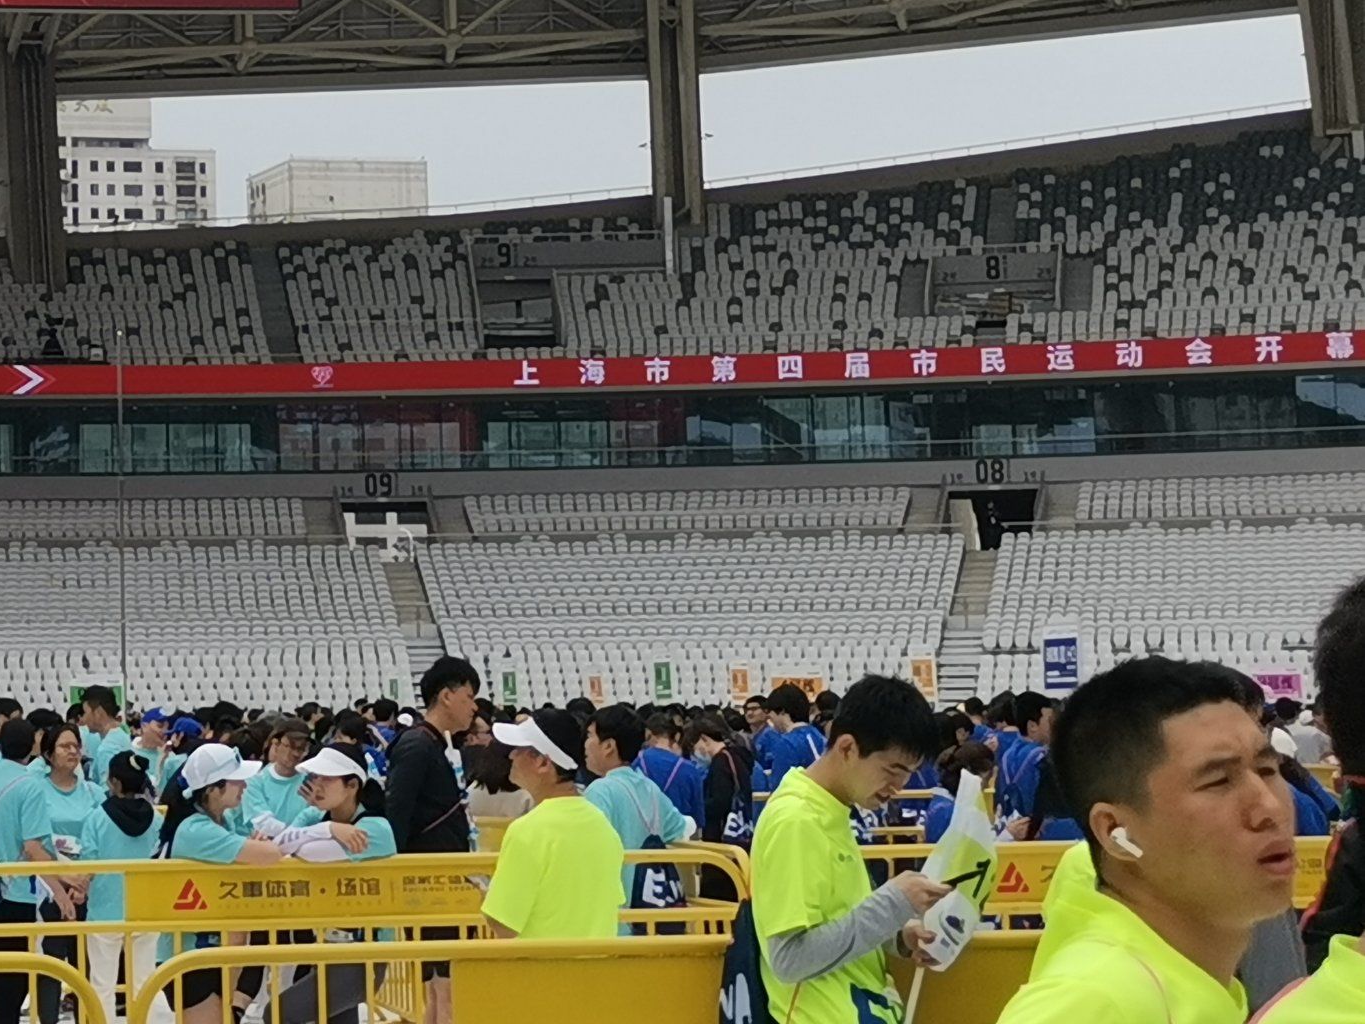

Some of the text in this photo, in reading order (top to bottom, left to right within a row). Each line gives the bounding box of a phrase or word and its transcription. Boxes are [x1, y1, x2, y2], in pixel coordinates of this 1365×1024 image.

[497, 242, 511, 268] 9
[985, 255, 1000, 280] 8
[513, 332, 1354, 386] 上海市第四届市民运动会开幕
[975, 458, 1004, 484] 08
[364, 472, 392, 497] 09
